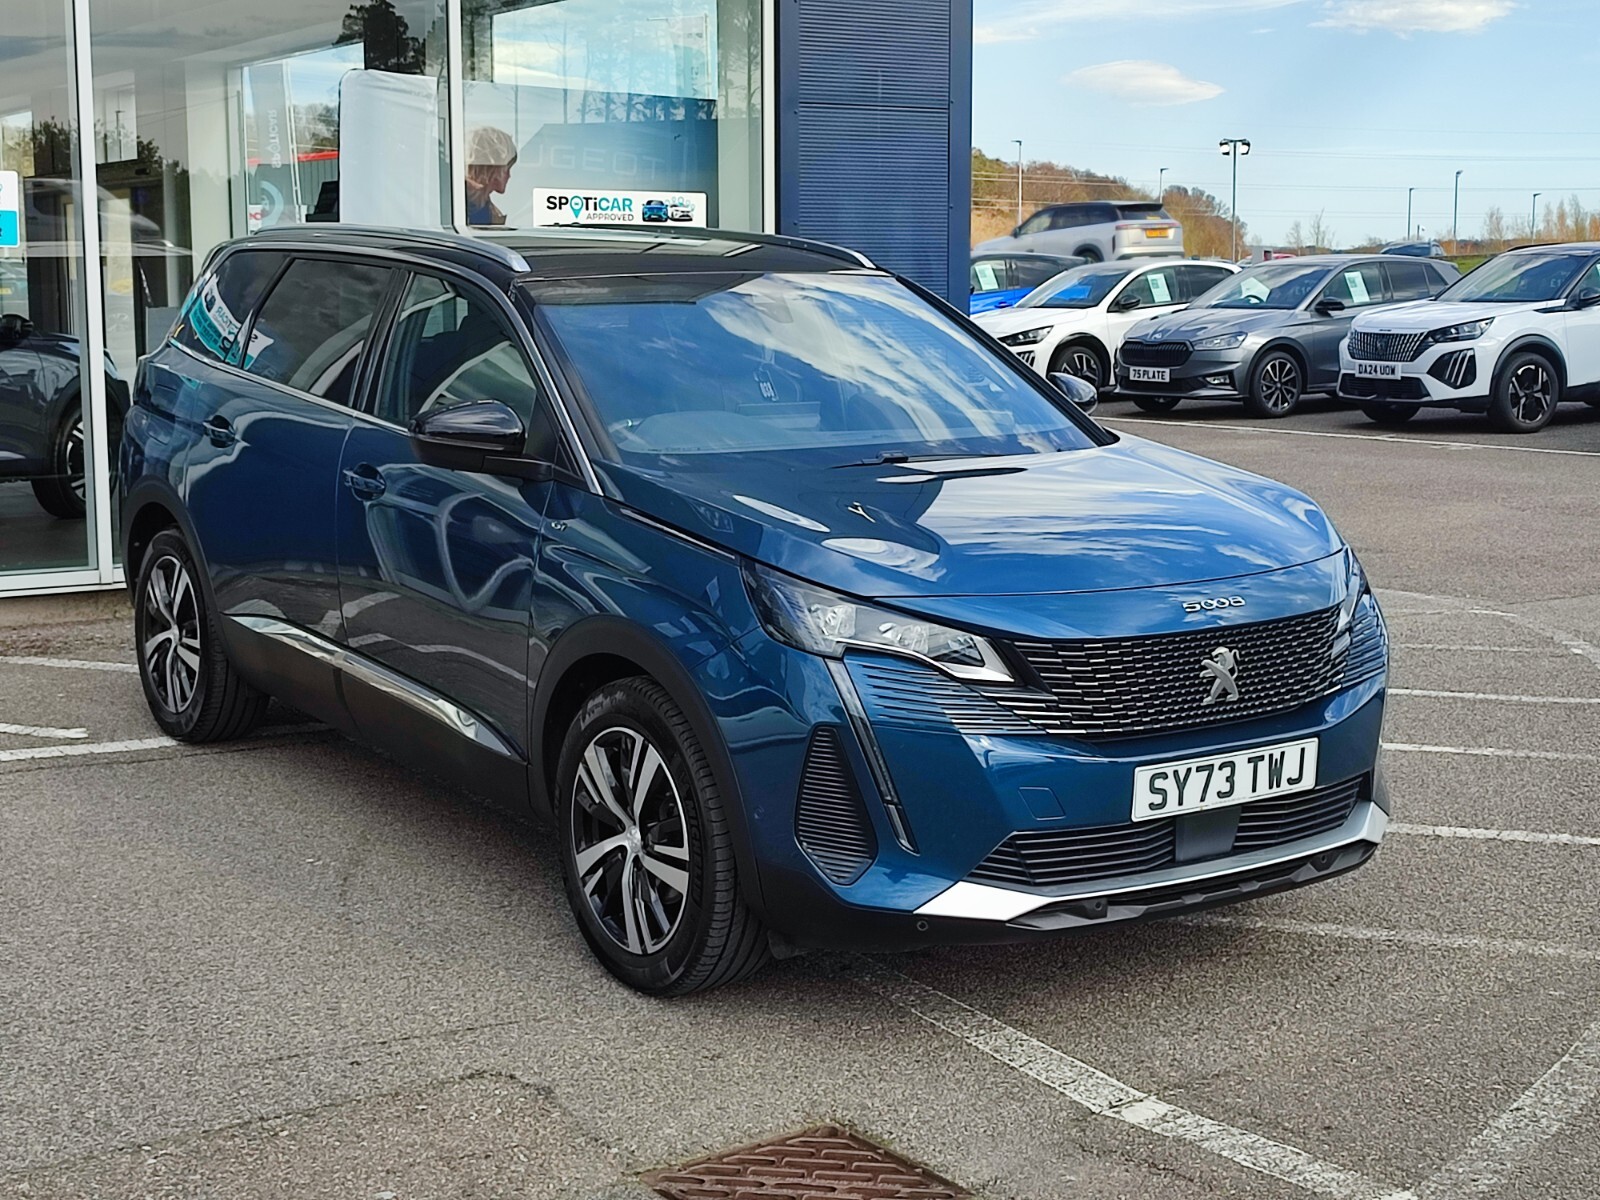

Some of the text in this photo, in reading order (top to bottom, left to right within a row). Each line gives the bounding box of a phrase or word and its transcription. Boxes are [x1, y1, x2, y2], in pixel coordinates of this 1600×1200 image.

[518, 143, 666, 181] UGEOT
[585, 212, 635, 222] APPROVED
[1132, 368, 1166, 381] 75 PLATE
[1358, 363, 1378, 375] DA24
[1182, 595, 1246, 613] 5008
[1148, 746, 1306, 811] SY73 TWJ
[683, 799, 704, 904] MICHELIN
